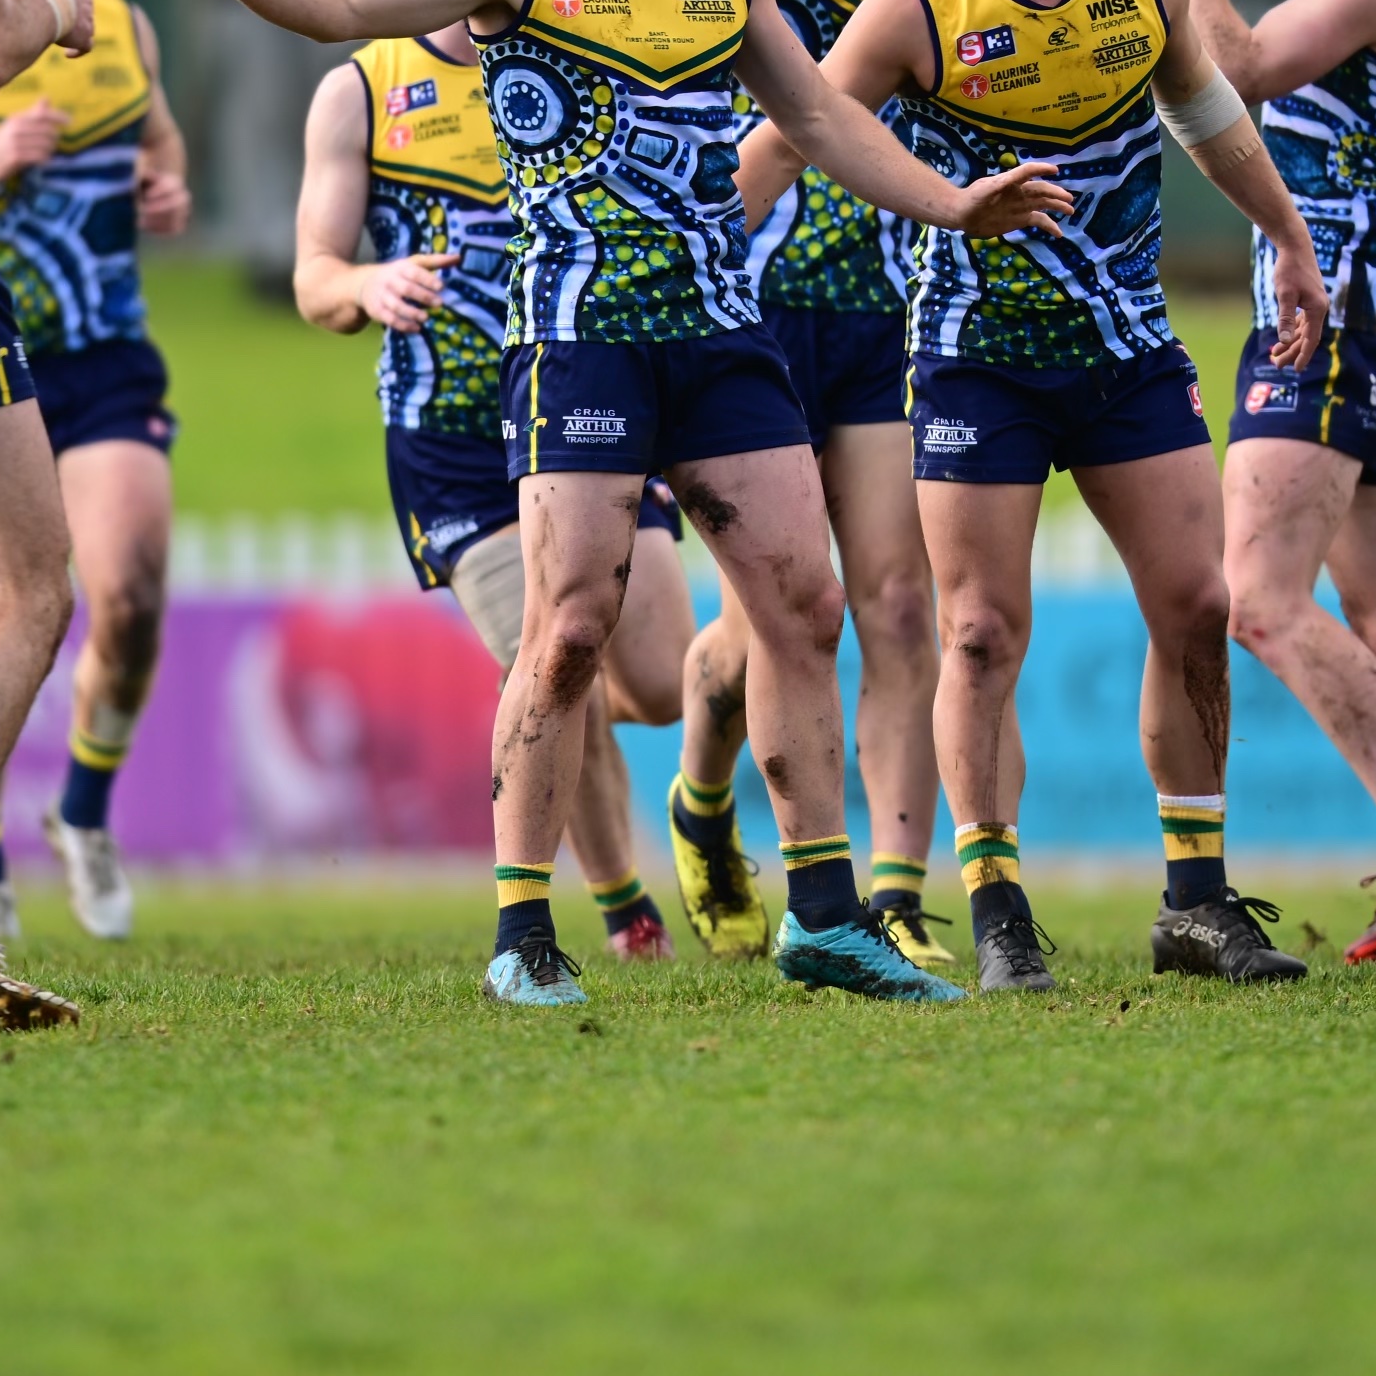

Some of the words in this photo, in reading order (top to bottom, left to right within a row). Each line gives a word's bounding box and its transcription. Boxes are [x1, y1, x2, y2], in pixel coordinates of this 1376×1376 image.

[584, 4, 632, 16] CLEANING
[682, 0, 735, 11] ARTHUR
[685, 15, 736, 23] TRANSPORT
[1091, 12, 1142, 33] Employment
[1101, 30, 1139, 46] CRAIG
[1043, 47, 1061, 55] sports
[1097, 39, 1151, 64] ARTHUR
[1099, 55, 1151, 76] TRANSPORT
[989, 62, 1040, 83] LAURINEX
[991, 74, 1041, 93] CLEANING
[1031, 104, 1051, 113] FIRST
[1052, 97, 1081, 109] NATIONS
[1083, 92, 1107, 102] ROUND
[573, 408, 616, 417] CRAIG
[564, 419, 626, 432] ARTHUR
[933, 417, 965, 427] CRAIG
[565, 436, 619, 444] TRANSPORT
[925, 428, 977, 441] ARTHUR
[924, 444, 967, 454] TRANSPORT
